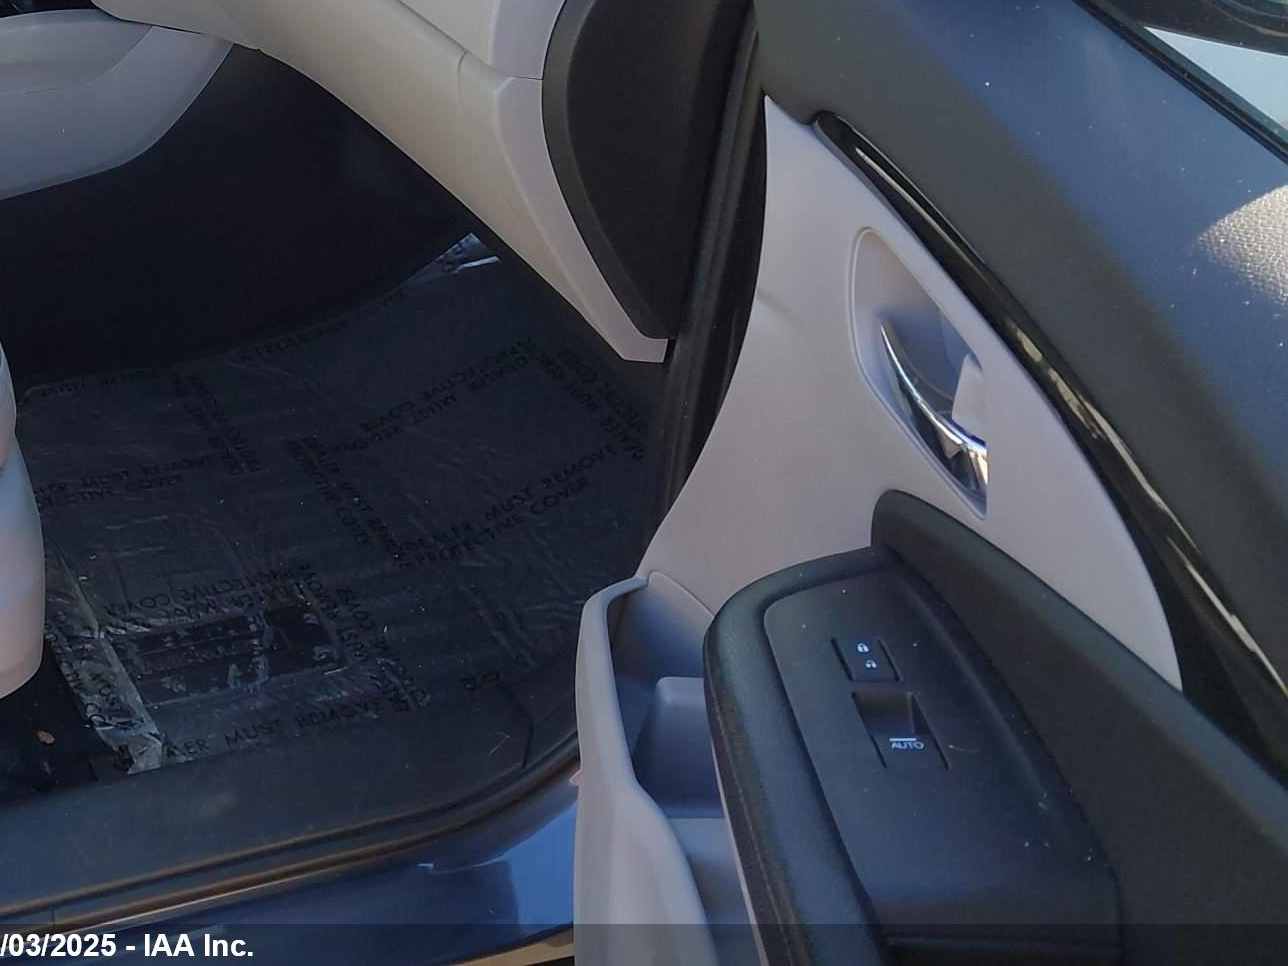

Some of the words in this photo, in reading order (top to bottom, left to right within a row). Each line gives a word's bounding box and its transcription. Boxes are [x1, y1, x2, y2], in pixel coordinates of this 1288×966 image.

[481, 486, 533, 522] MUST
[539, 440, 619, 490] REMOVE
[527, 474, 591, 517] COVER
[223, 718, 283, 746] MUST
[295, 696, 384, 728] REMOVE
[891, 741, 924, 750] AUTO
